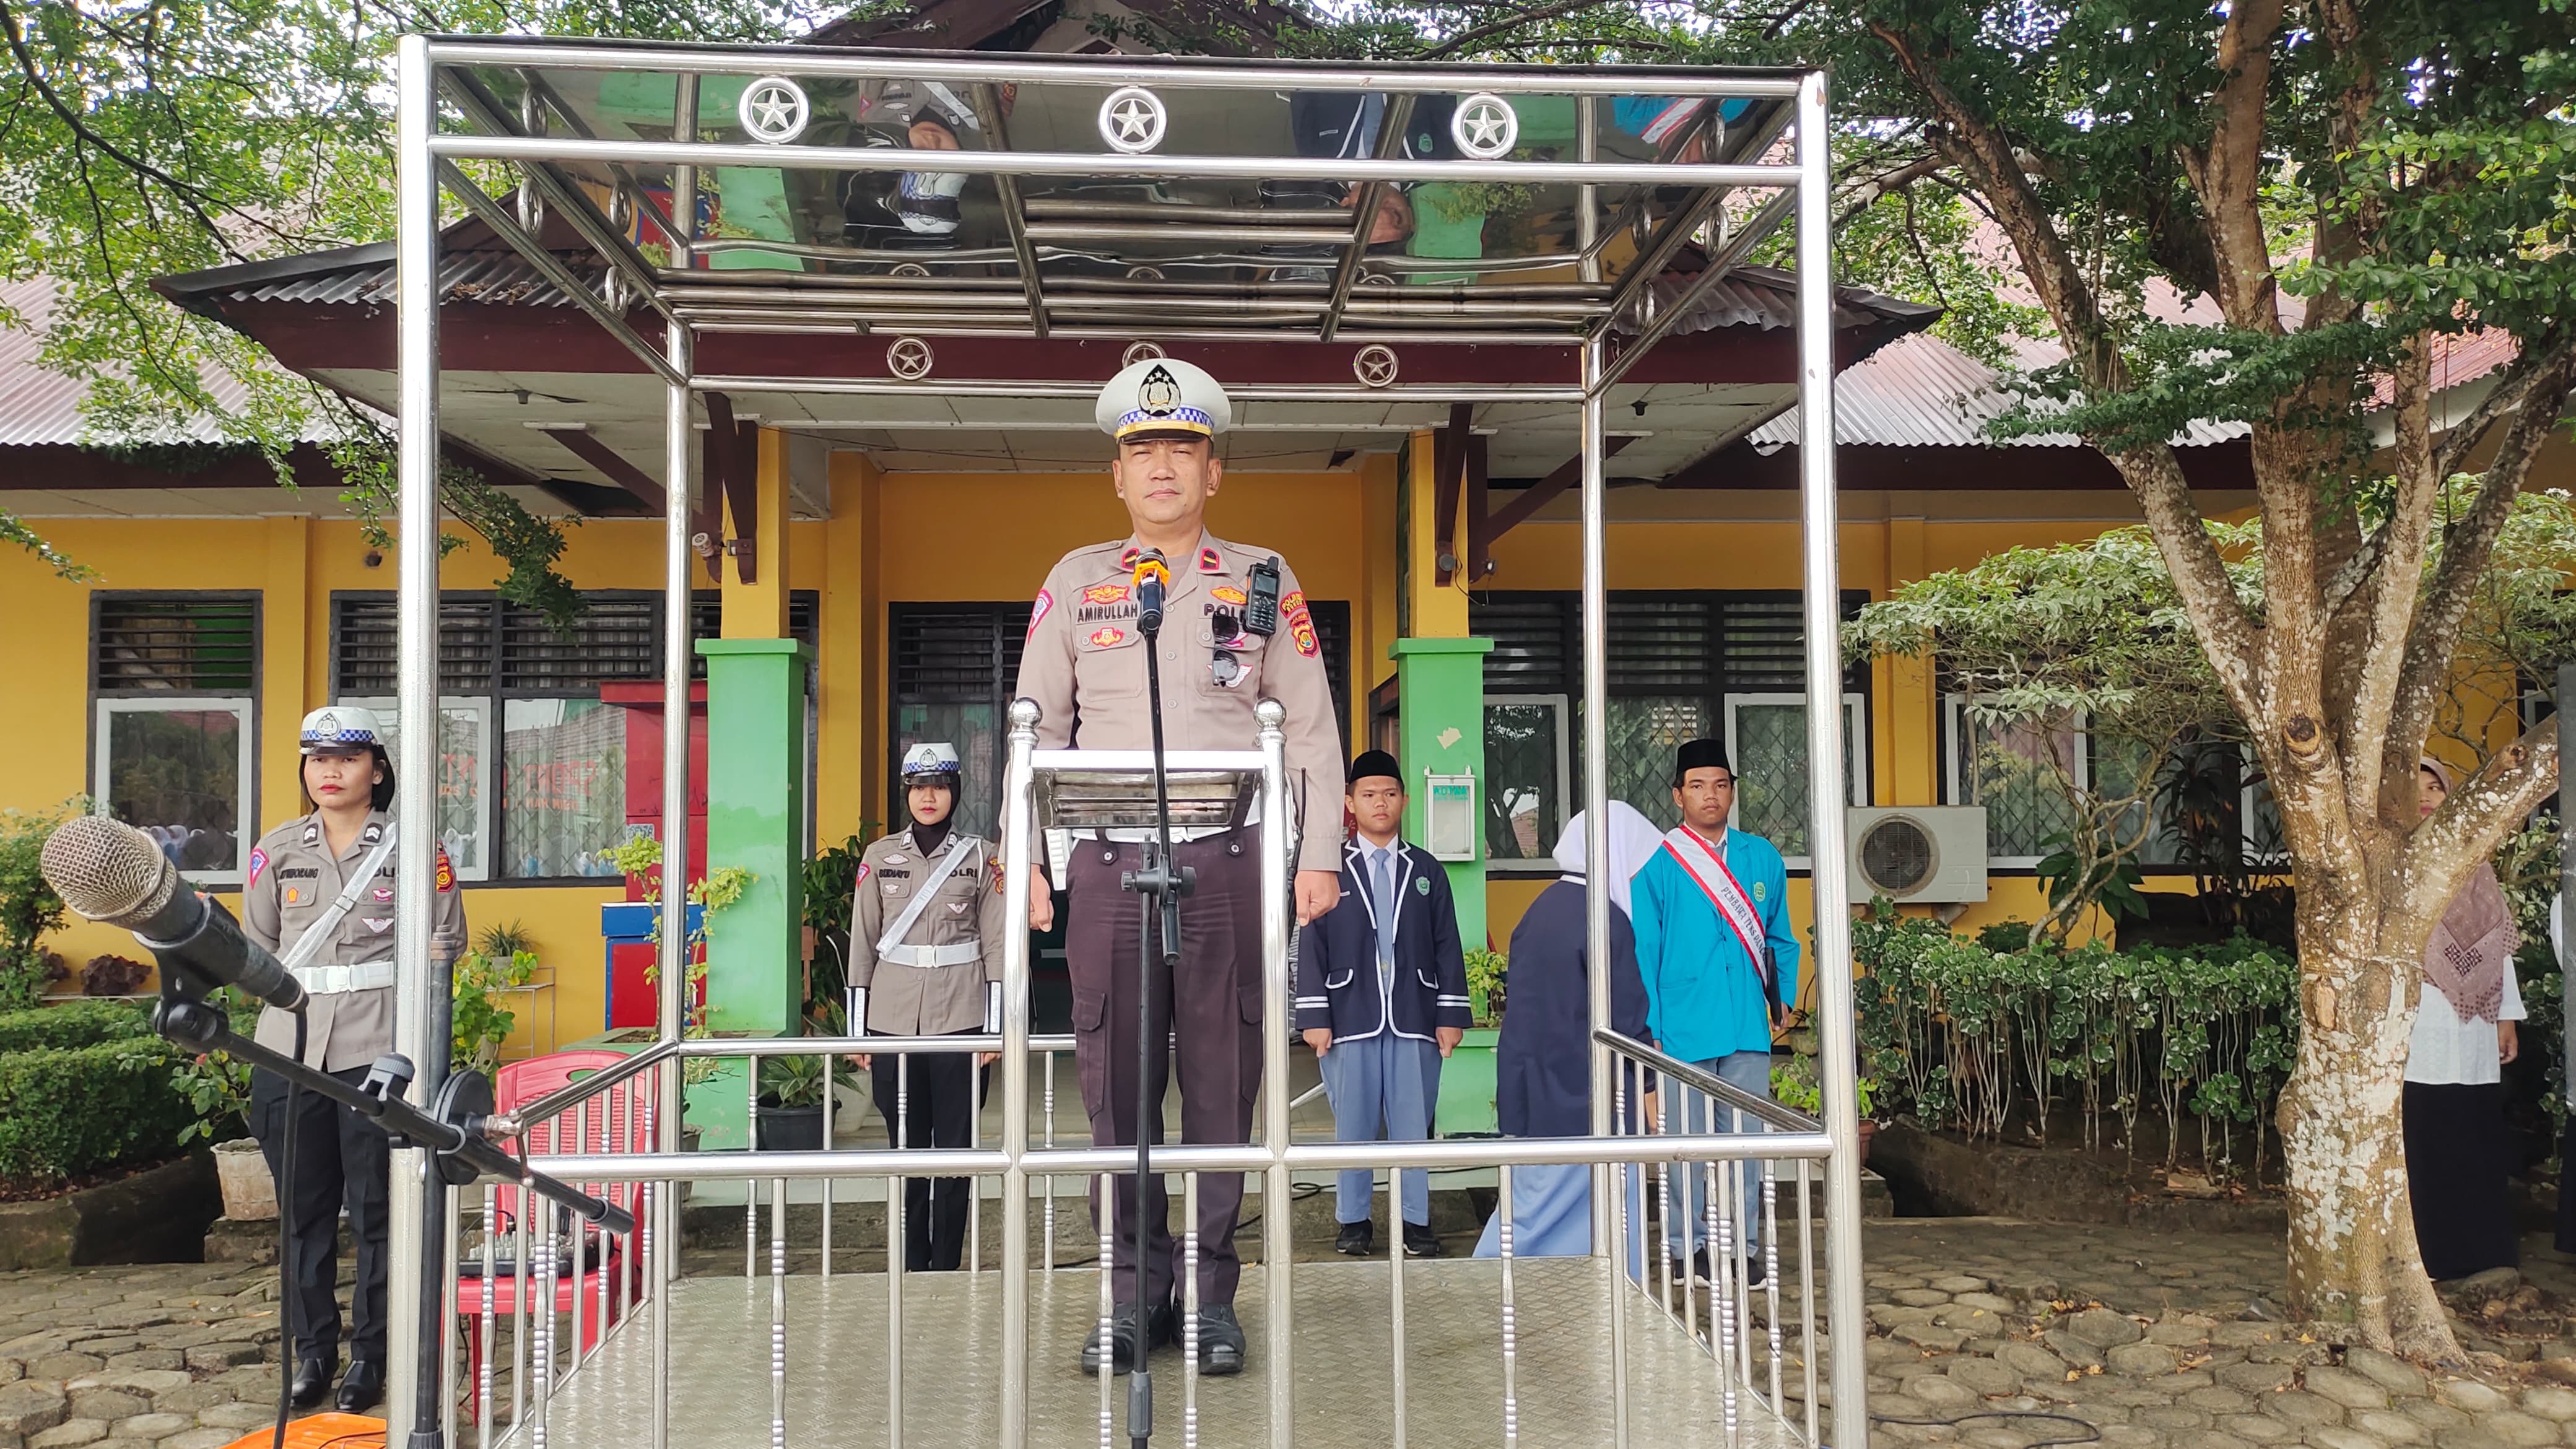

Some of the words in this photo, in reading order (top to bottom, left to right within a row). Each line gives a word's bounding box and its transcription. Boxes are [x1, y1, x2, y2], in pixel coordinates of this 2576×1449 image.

[1077, 603, 1138, 623] AMIRULLAH
[1721, 886, 1747, 920] PEMBAWA
[1744, 916, 1757, 936] TEKS
